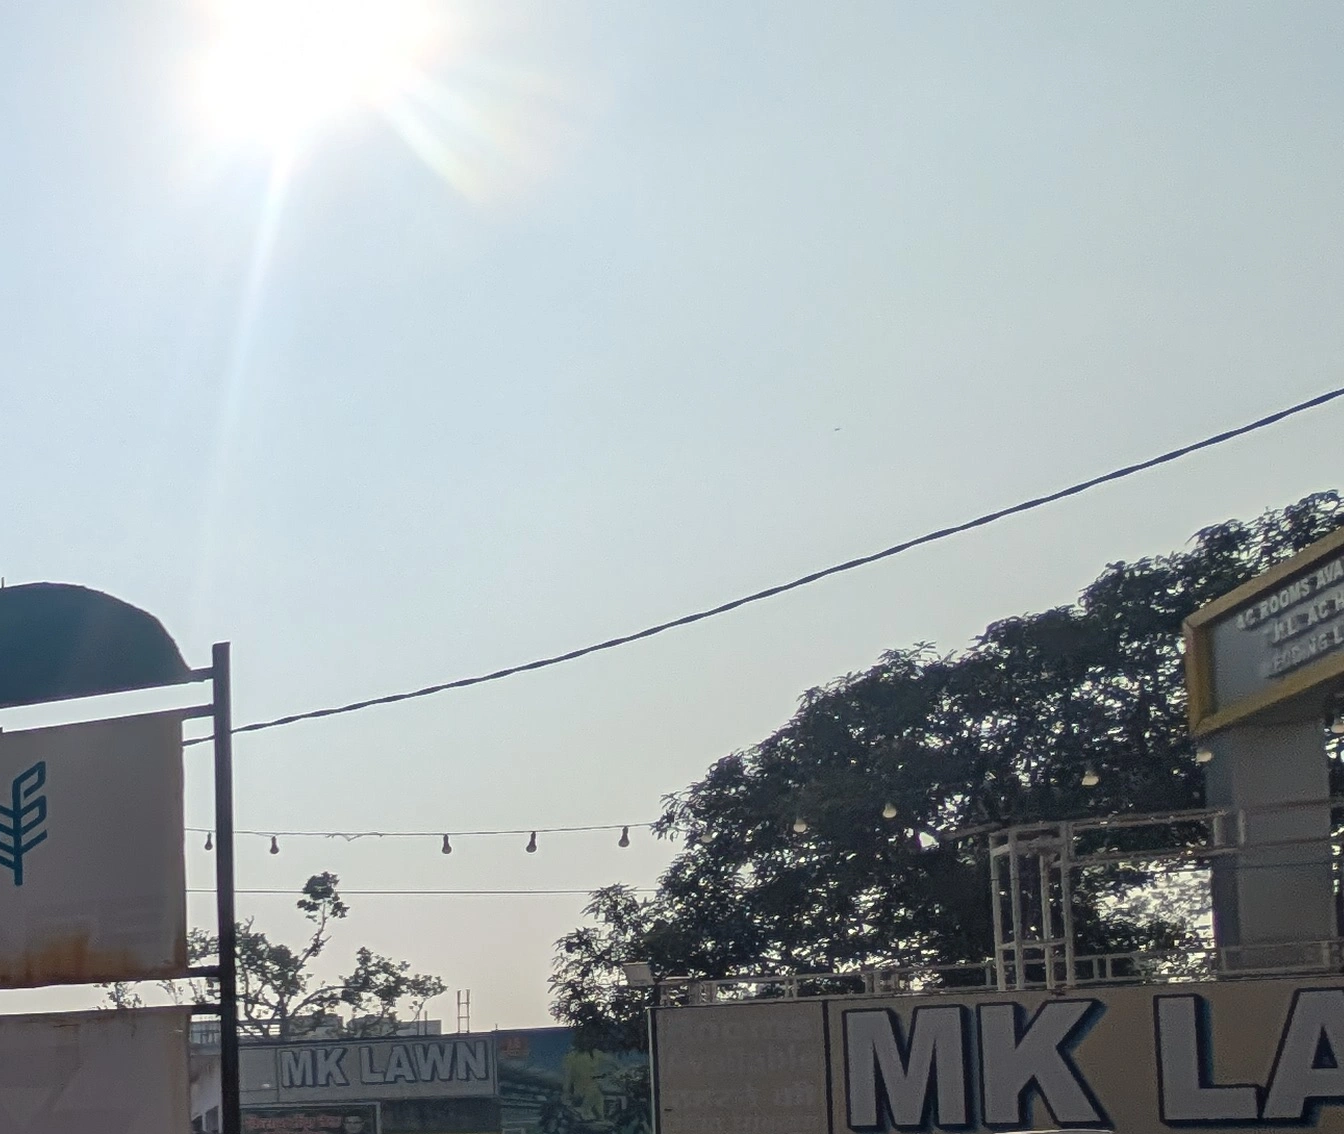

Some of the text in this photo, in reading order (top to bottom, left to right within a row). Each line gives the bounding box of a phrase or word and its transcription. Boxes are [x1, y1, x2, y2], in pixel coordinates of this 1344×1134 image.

[280, 1047, 350, 1089] MK
[359, 1039, 491, 1085] LAWN
[839, 986, 1344, 1134] MK LA
